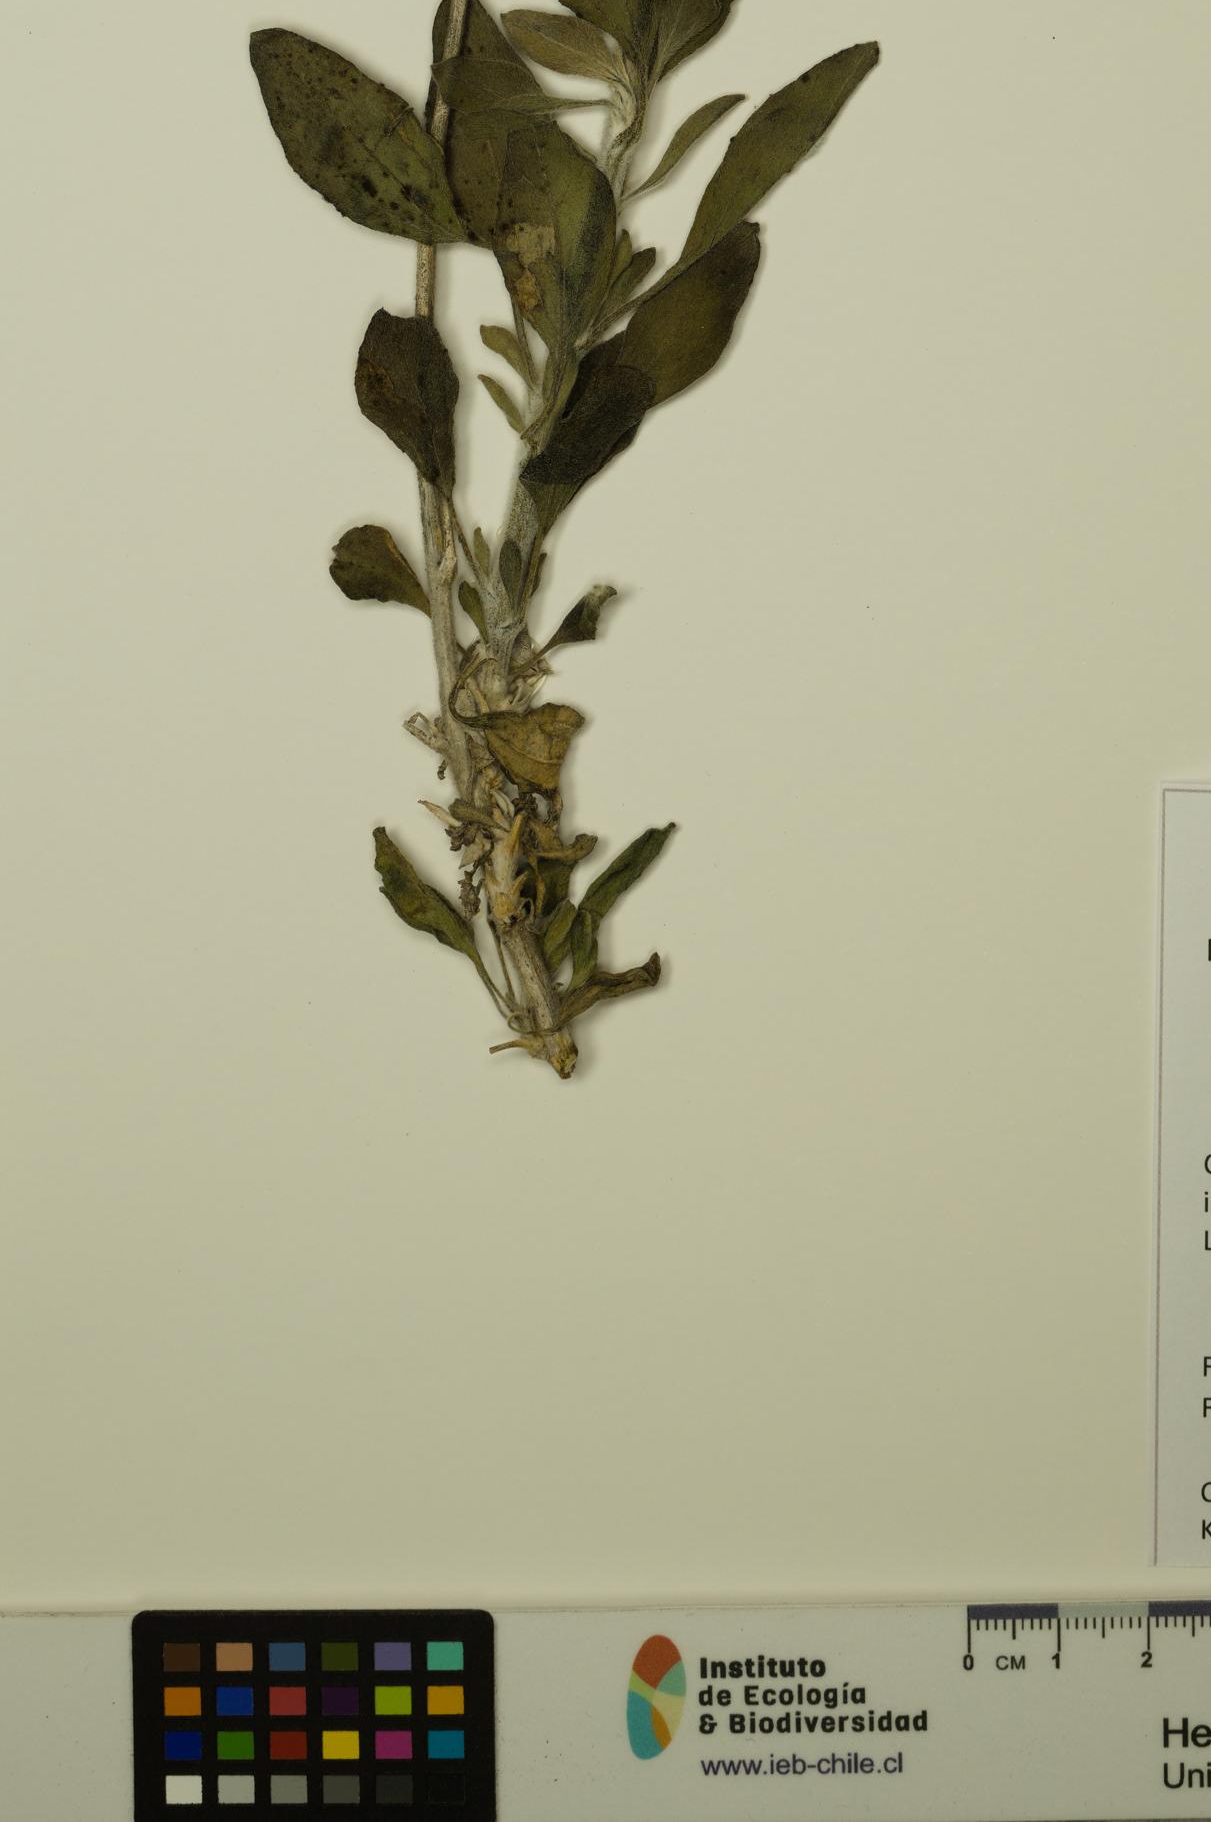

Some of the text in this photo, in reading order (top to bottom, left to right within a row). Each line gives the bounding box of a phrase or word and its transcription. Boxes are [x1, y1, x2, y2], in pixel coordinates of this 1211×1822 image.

[699, 1654, 827, 1680] Instituto
[962, 1653, 975, 1671] 0
[995, 1654, 1026, 1671] CM
[1051, 1652, 1062, 1669] 1
[1140, 1650, 1153, 1668] 2
[697, 1681, 867, 1709] de Ecología
[698, 1709, 929, 1735] & Biodiversidad
[700, 1751, 904, 1776] www.ieb-chile.cl
